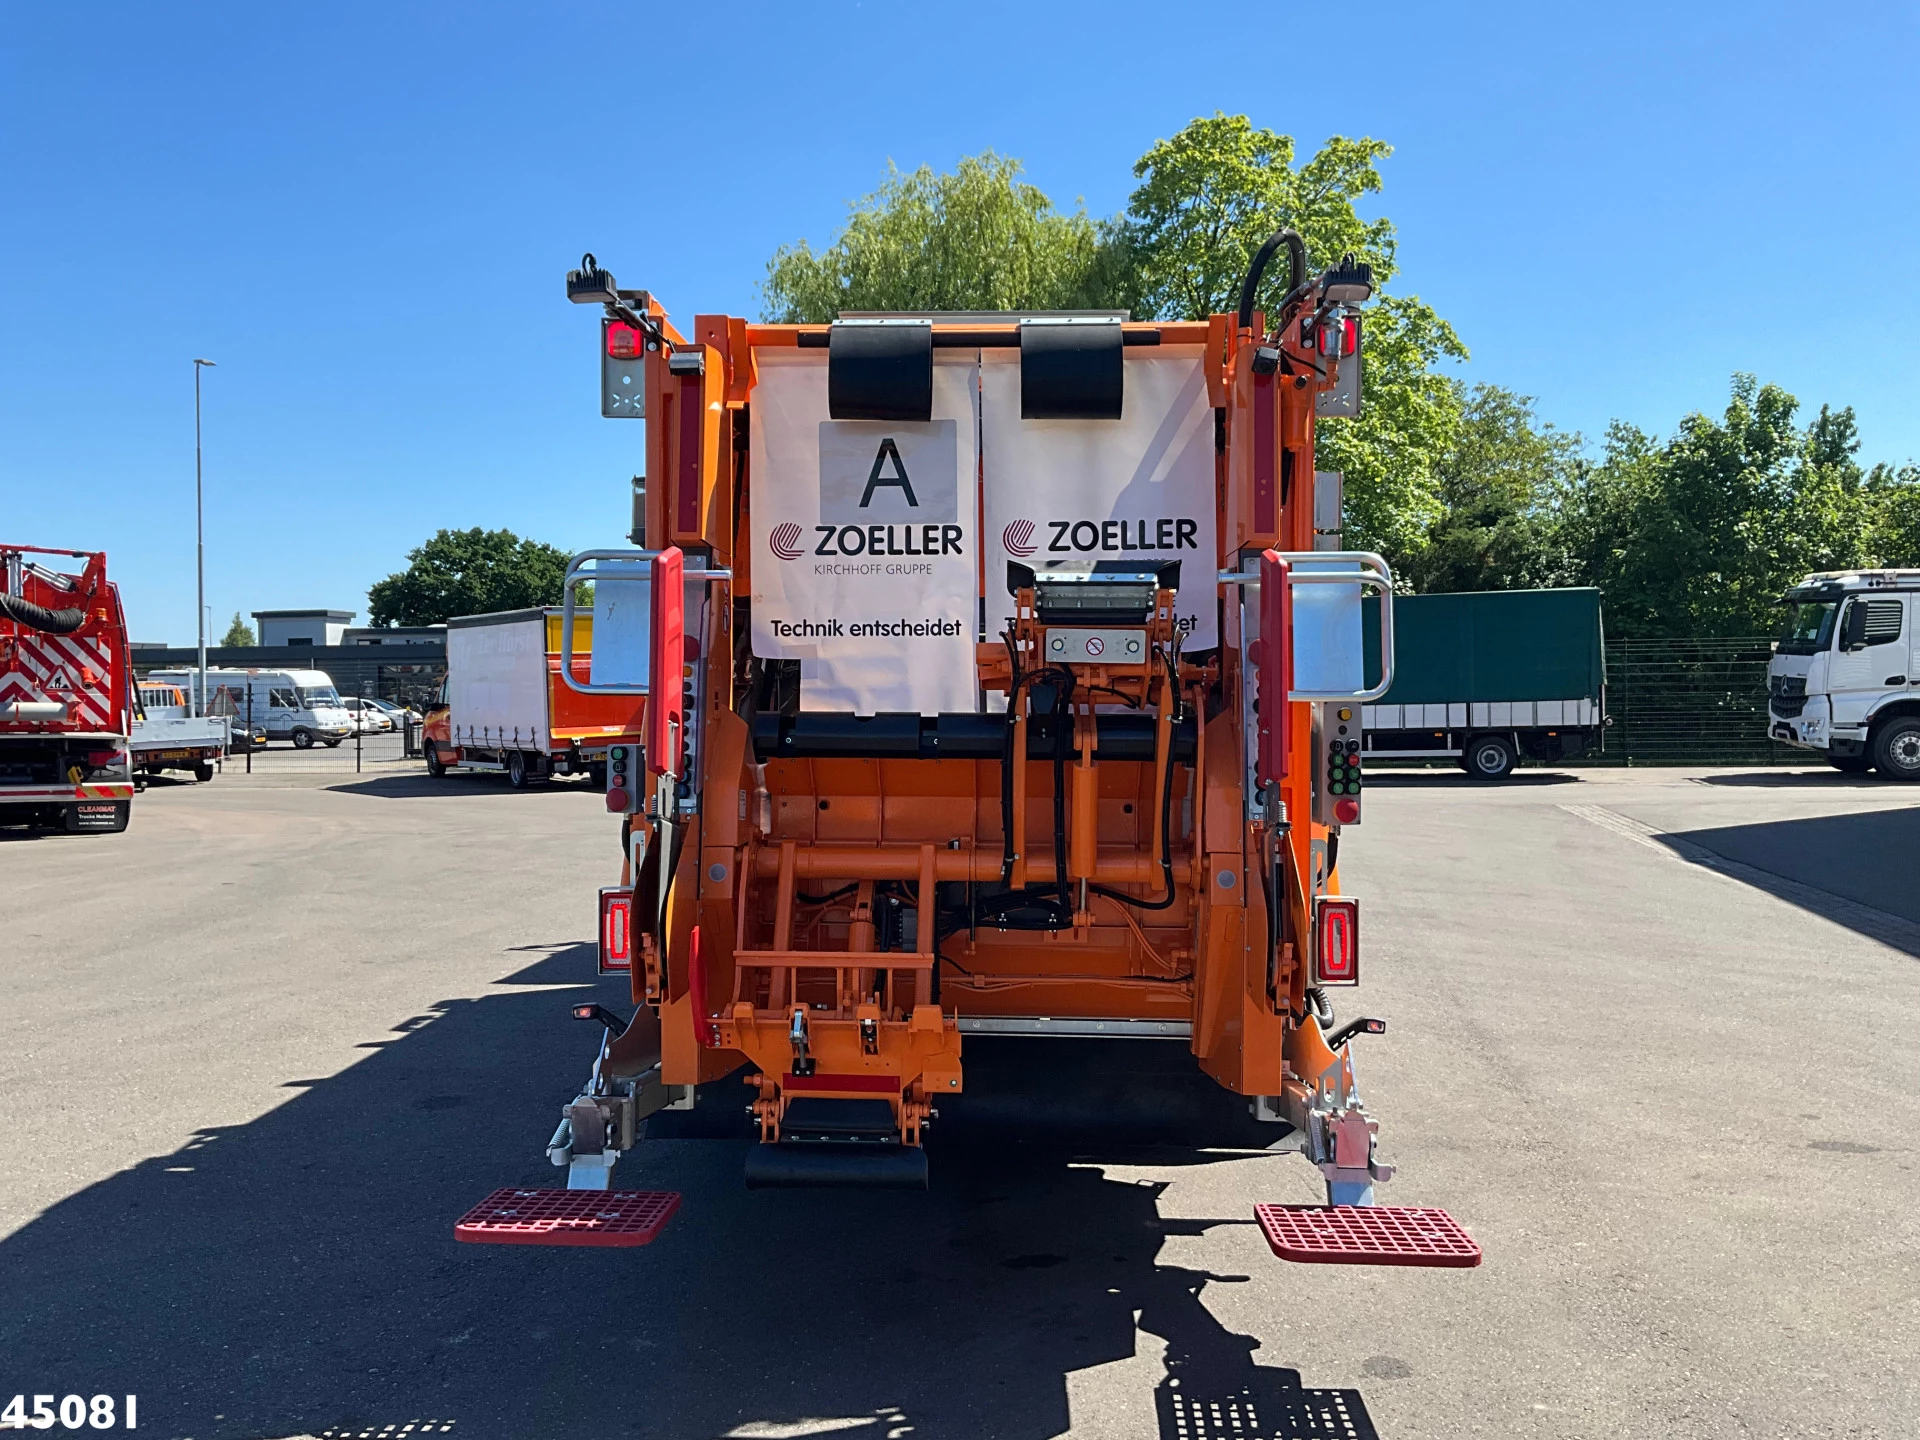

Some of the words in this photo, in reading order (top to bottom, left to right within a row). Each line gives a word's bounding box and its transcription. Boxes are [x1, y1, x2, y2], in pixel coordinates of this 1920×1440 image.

[859, 438, 919, 508] A
[814, 525, 963, 556] ZOELLER
[1048, 518, 1198, 552] ZOELLER
[814, 564, 882, 575] KIRCHHOFF
[885, 564, 933, 575] GRUPPE
[771, 619, 844, 637] Technik
[849, 618, 962, 637] entscheidet
